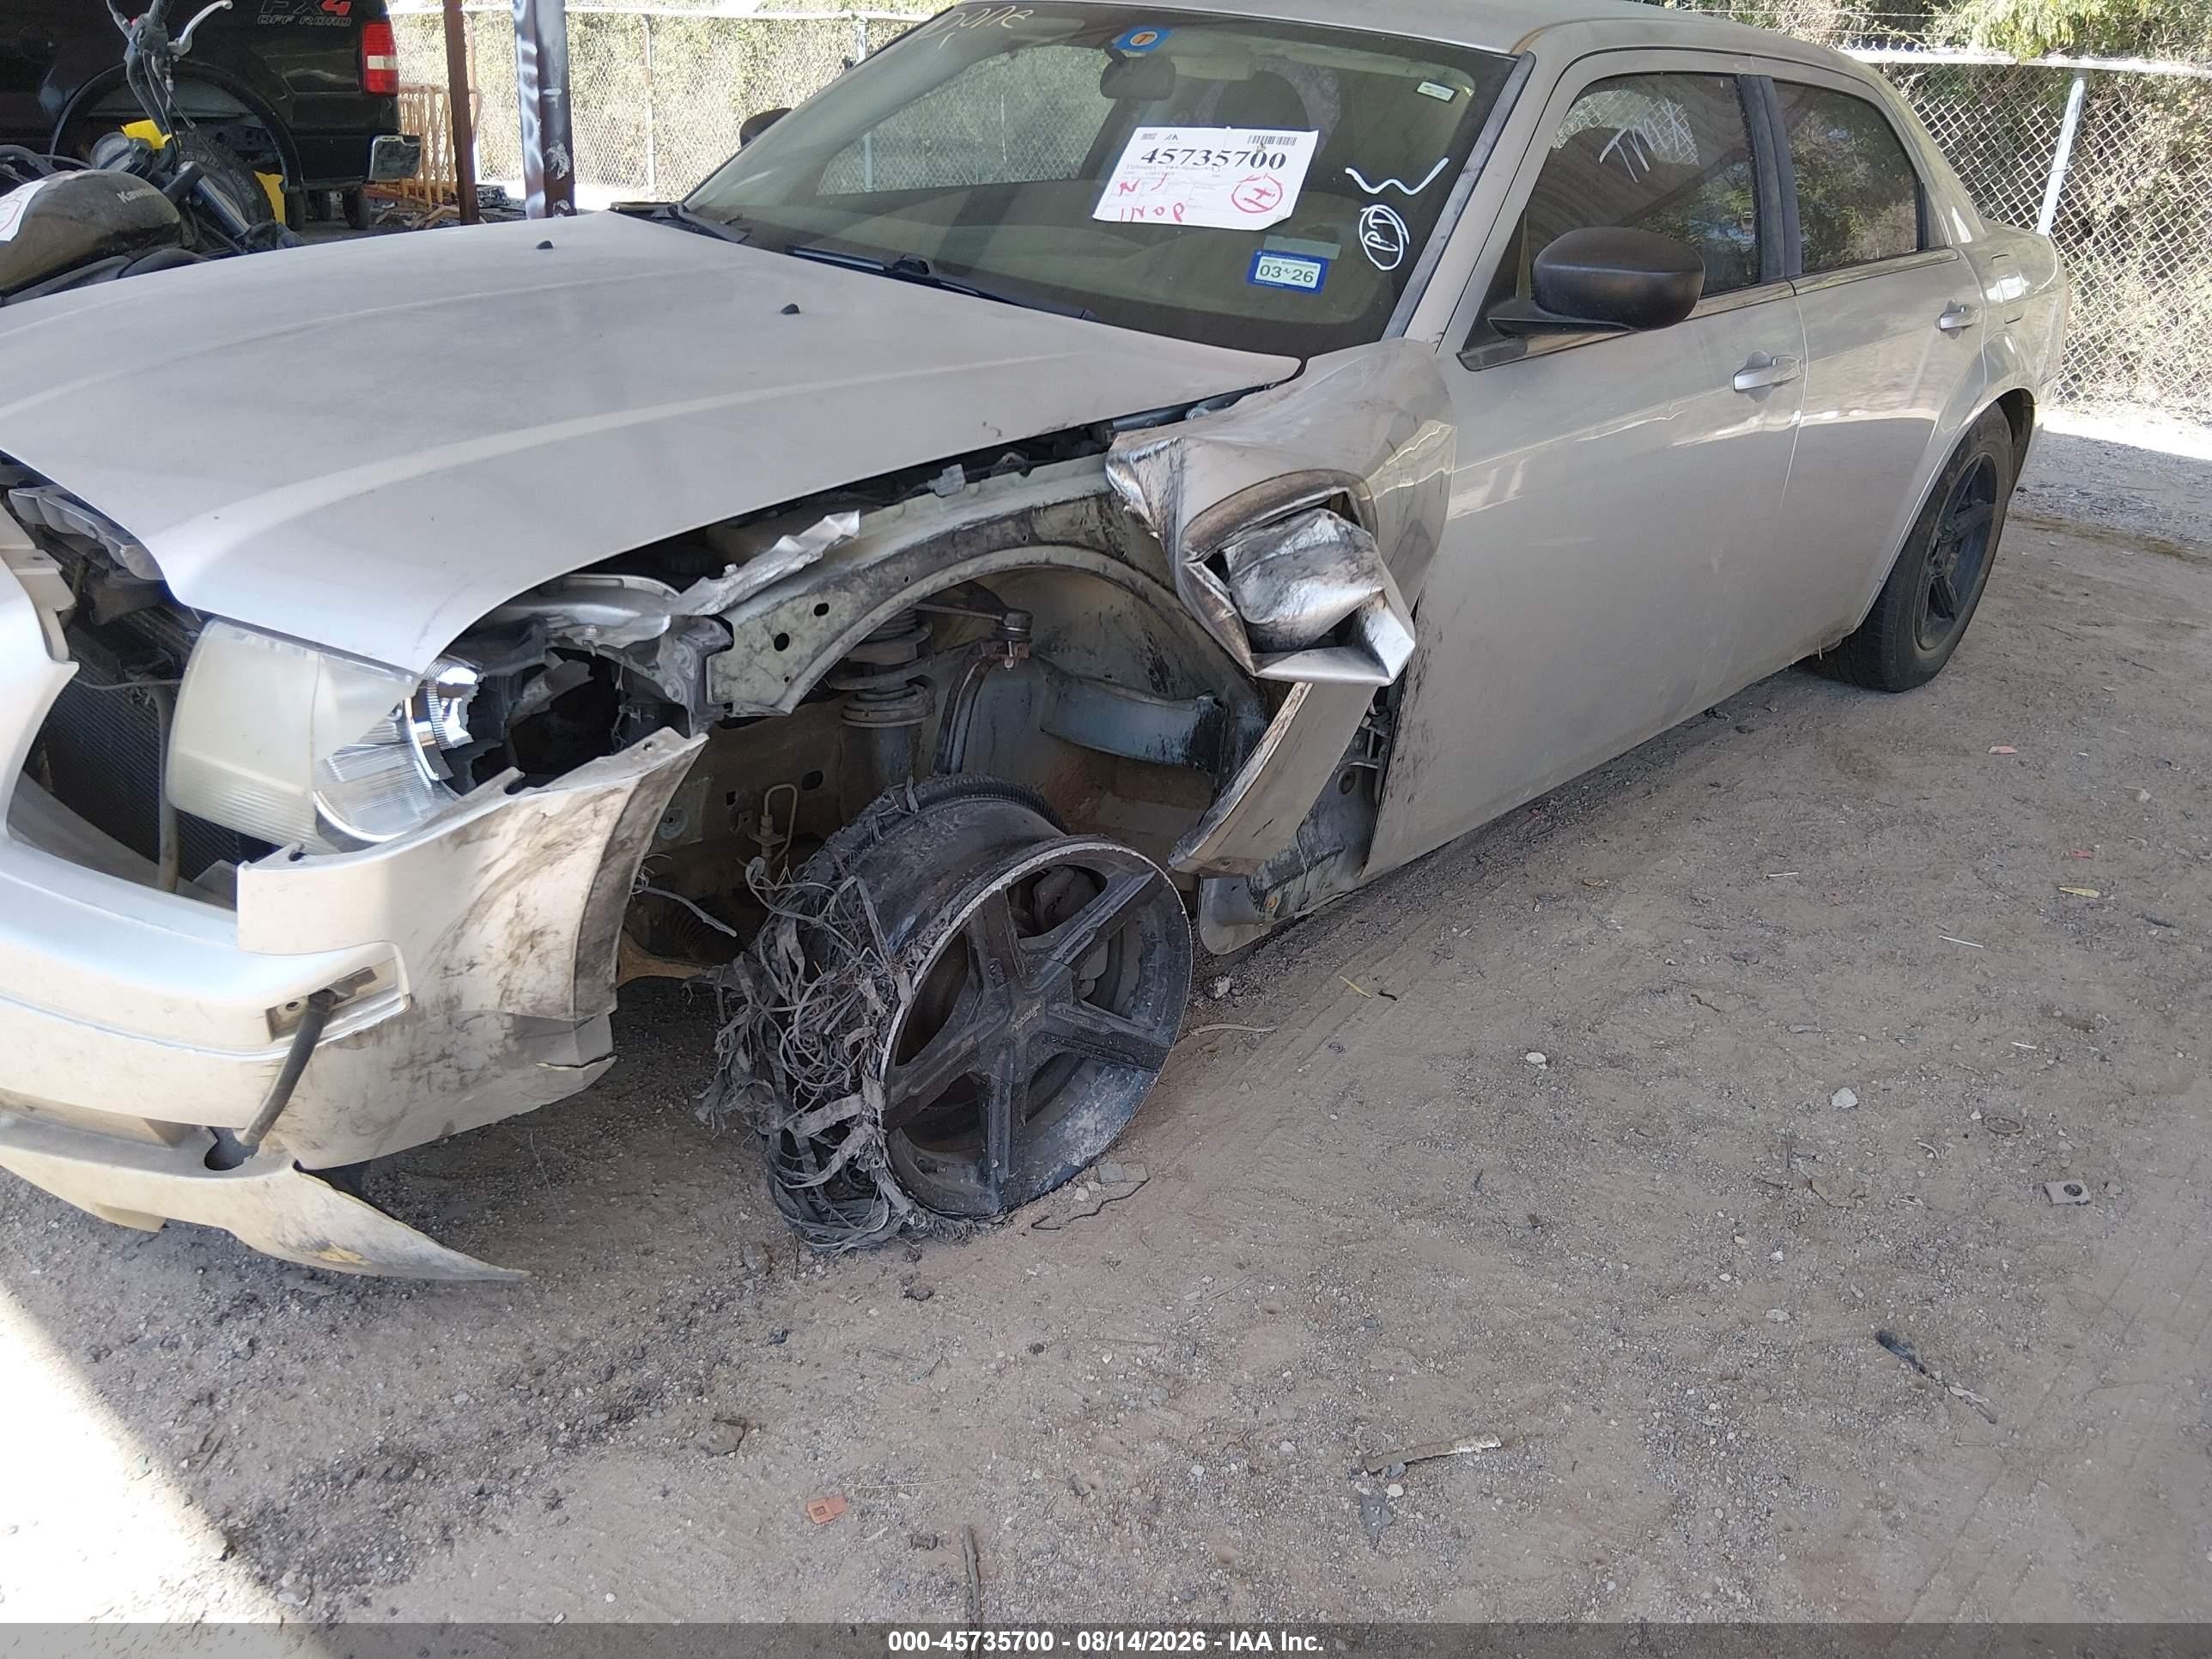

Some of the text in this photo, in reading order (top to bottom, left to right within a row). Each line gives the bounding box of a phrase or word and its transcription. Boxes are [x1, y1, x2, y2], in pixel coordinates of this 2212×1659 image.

[258, 15, 351, 27] OFF ROAD
[1140, 148, 1286, 170] 45735700
[1259, 264, 1316, 283] 03 26
